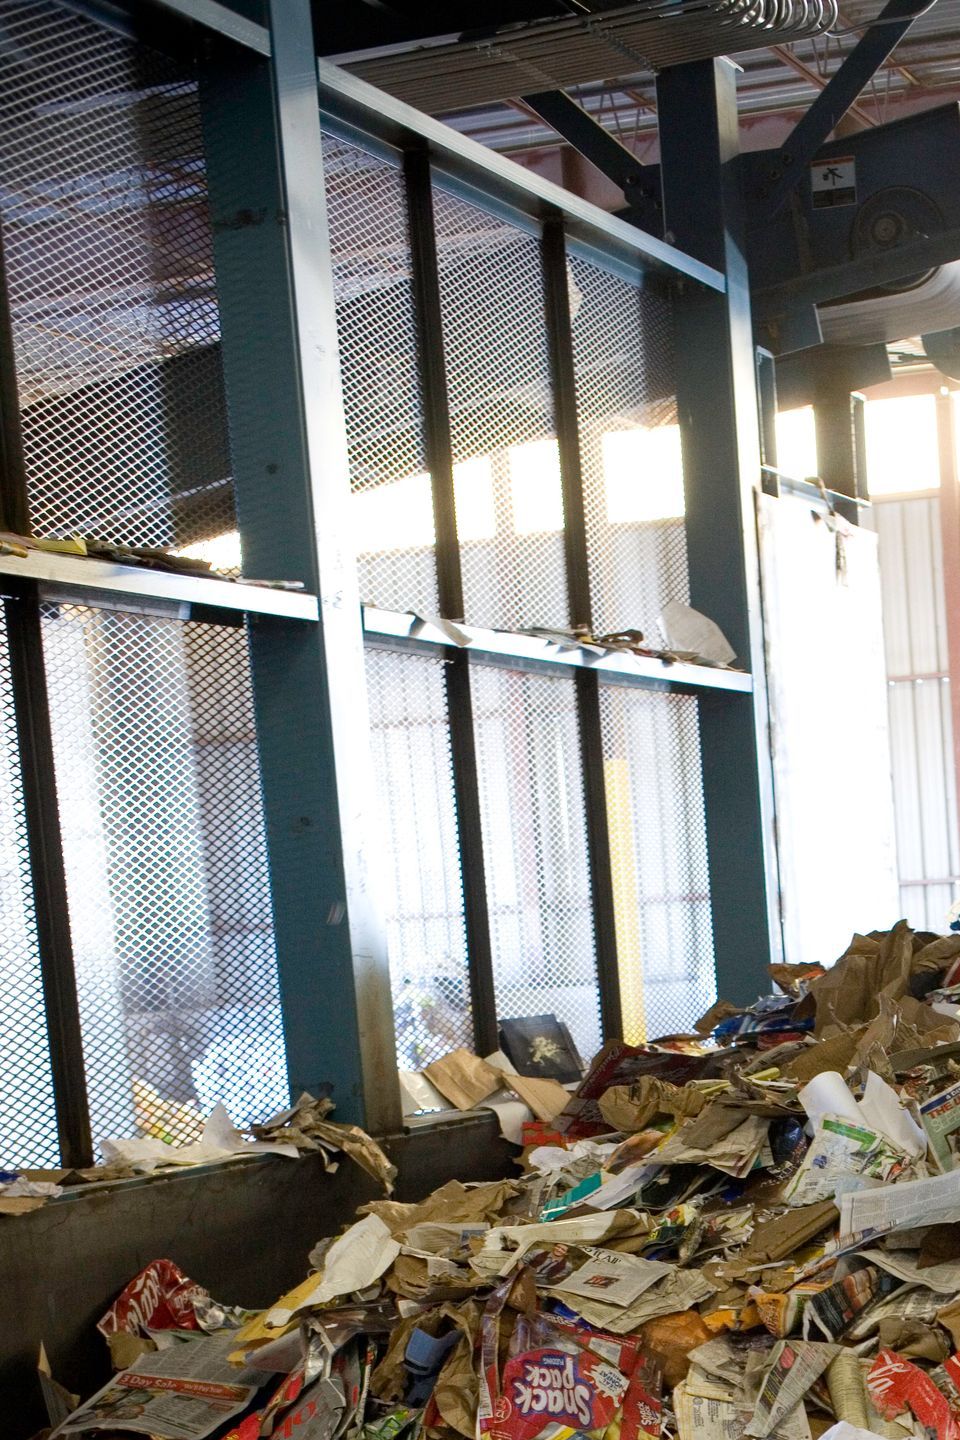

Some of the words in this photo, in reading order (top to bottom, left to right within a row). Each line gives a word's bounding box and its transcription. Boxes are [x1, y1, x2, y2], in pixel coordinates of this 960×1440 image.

[930, 1100, 954, 1119] THE
[525, 1358, 574, 1390] pack
[515, 1383, 592, 1426] Snack
